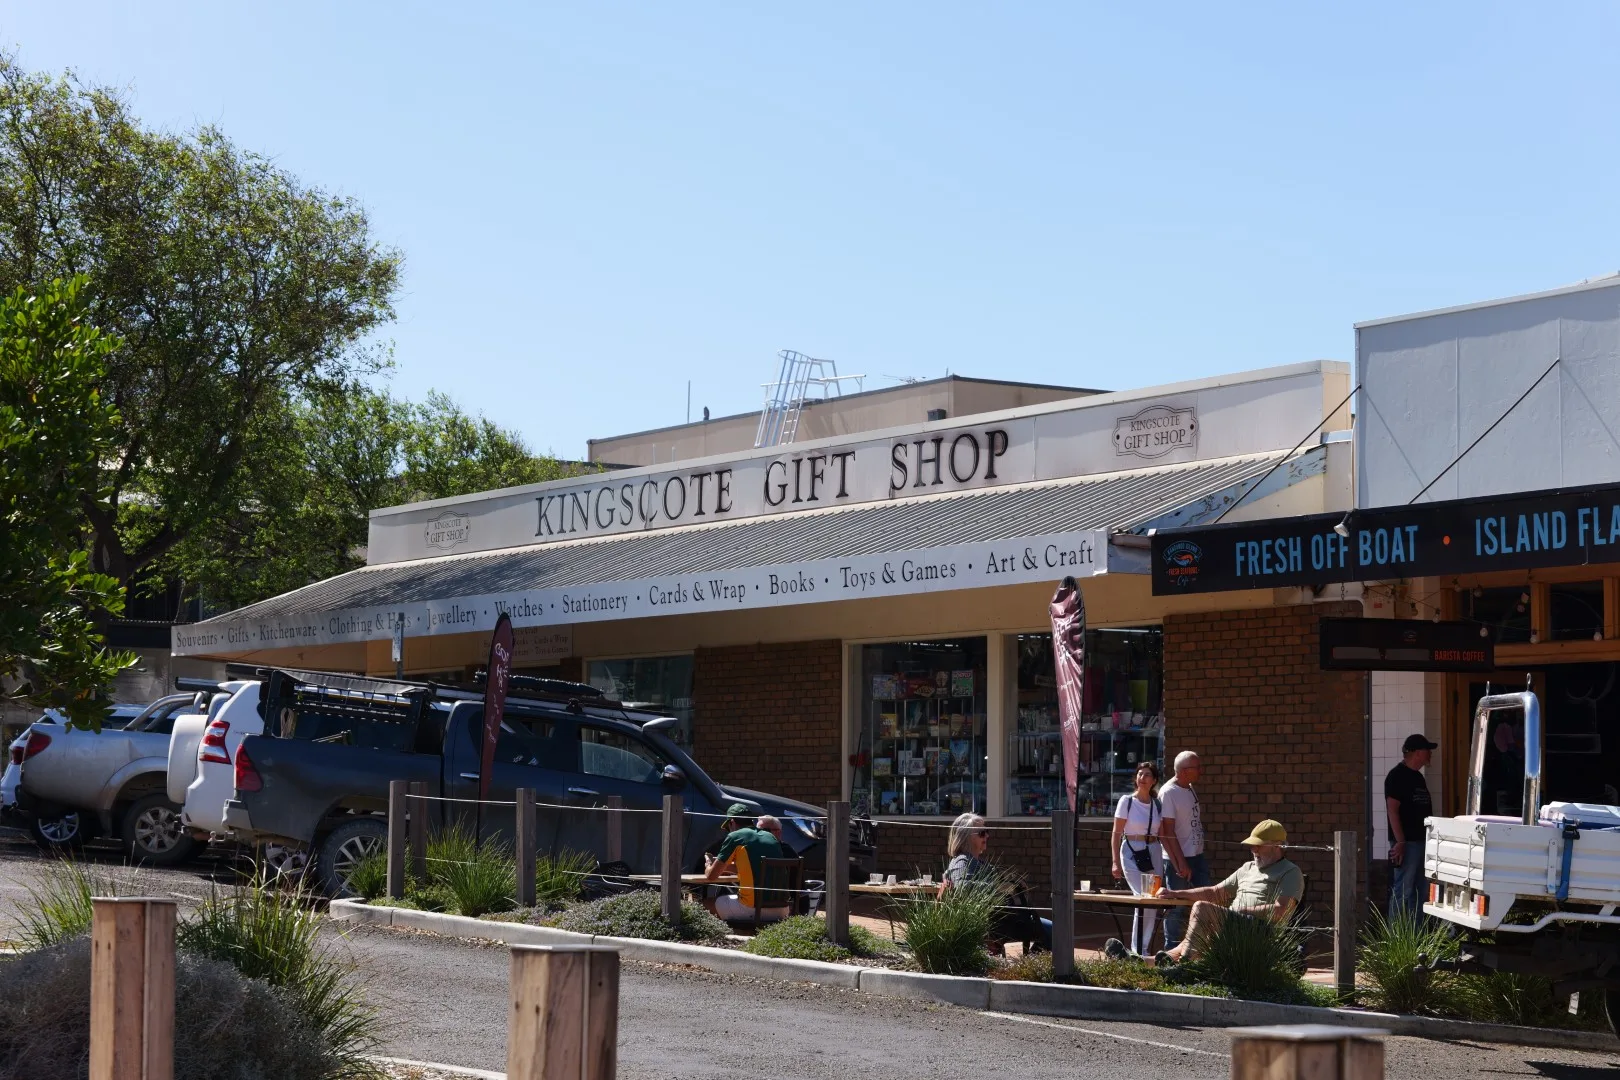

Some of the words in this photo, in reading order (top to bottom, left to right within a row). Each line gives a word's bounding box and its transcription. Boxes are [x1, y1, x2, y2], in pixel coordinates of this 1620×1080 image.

[1130, 414, 1180, 431] KINGSCOTE
[1124, 434, 1151, 449] GIFT
[1154, 429, 1186, 446] SHOP
[534, 468, 733, 537] KINGSCOTE
[764, 450, 856, 507] GIFT
[890, 429, 1009, 491] SHOP
[430, 531, 445, 543] GIFT
[446, 528, 464, 541] SHOP
[1235, 536, 1302, 577] FRESH
[1311, 532, 1348, 571] OFF
[1359, 525, 1419, 566] BOAT
[1475, 510, 1567, 556] ISLAND
[176, 631, 218, 648] Souvenirs
[227, 627, 250, 643] Gifts
[259, 624, 317, 641] Kitchenware
[329, 617, 373, 635] Clothing
[375, 613, 385, 630] &
[426, 608, 477, 630] Jewellery
[495, 600, 543, 618] Watches
[562, 593, 629, 613] Stationery
[649, 583, 688, 605] Cards
[692, 581, 705, 602] &
[708, 579, 746, 602] Wrap
[768, 571, 815, 595] Books
[840, 566, 876, 591] Toys
[881, 562, 896, 584] &
[901, 559, 957, 582] Games
[985, 551, 1016, 574] Art
[1022, 547, 1038, 570] &
[1044, 540, 1093, 567] Craft
[1434, 650, 1461, 661] BARISTA
[1462, 651, 1485, 662] COFFEE
